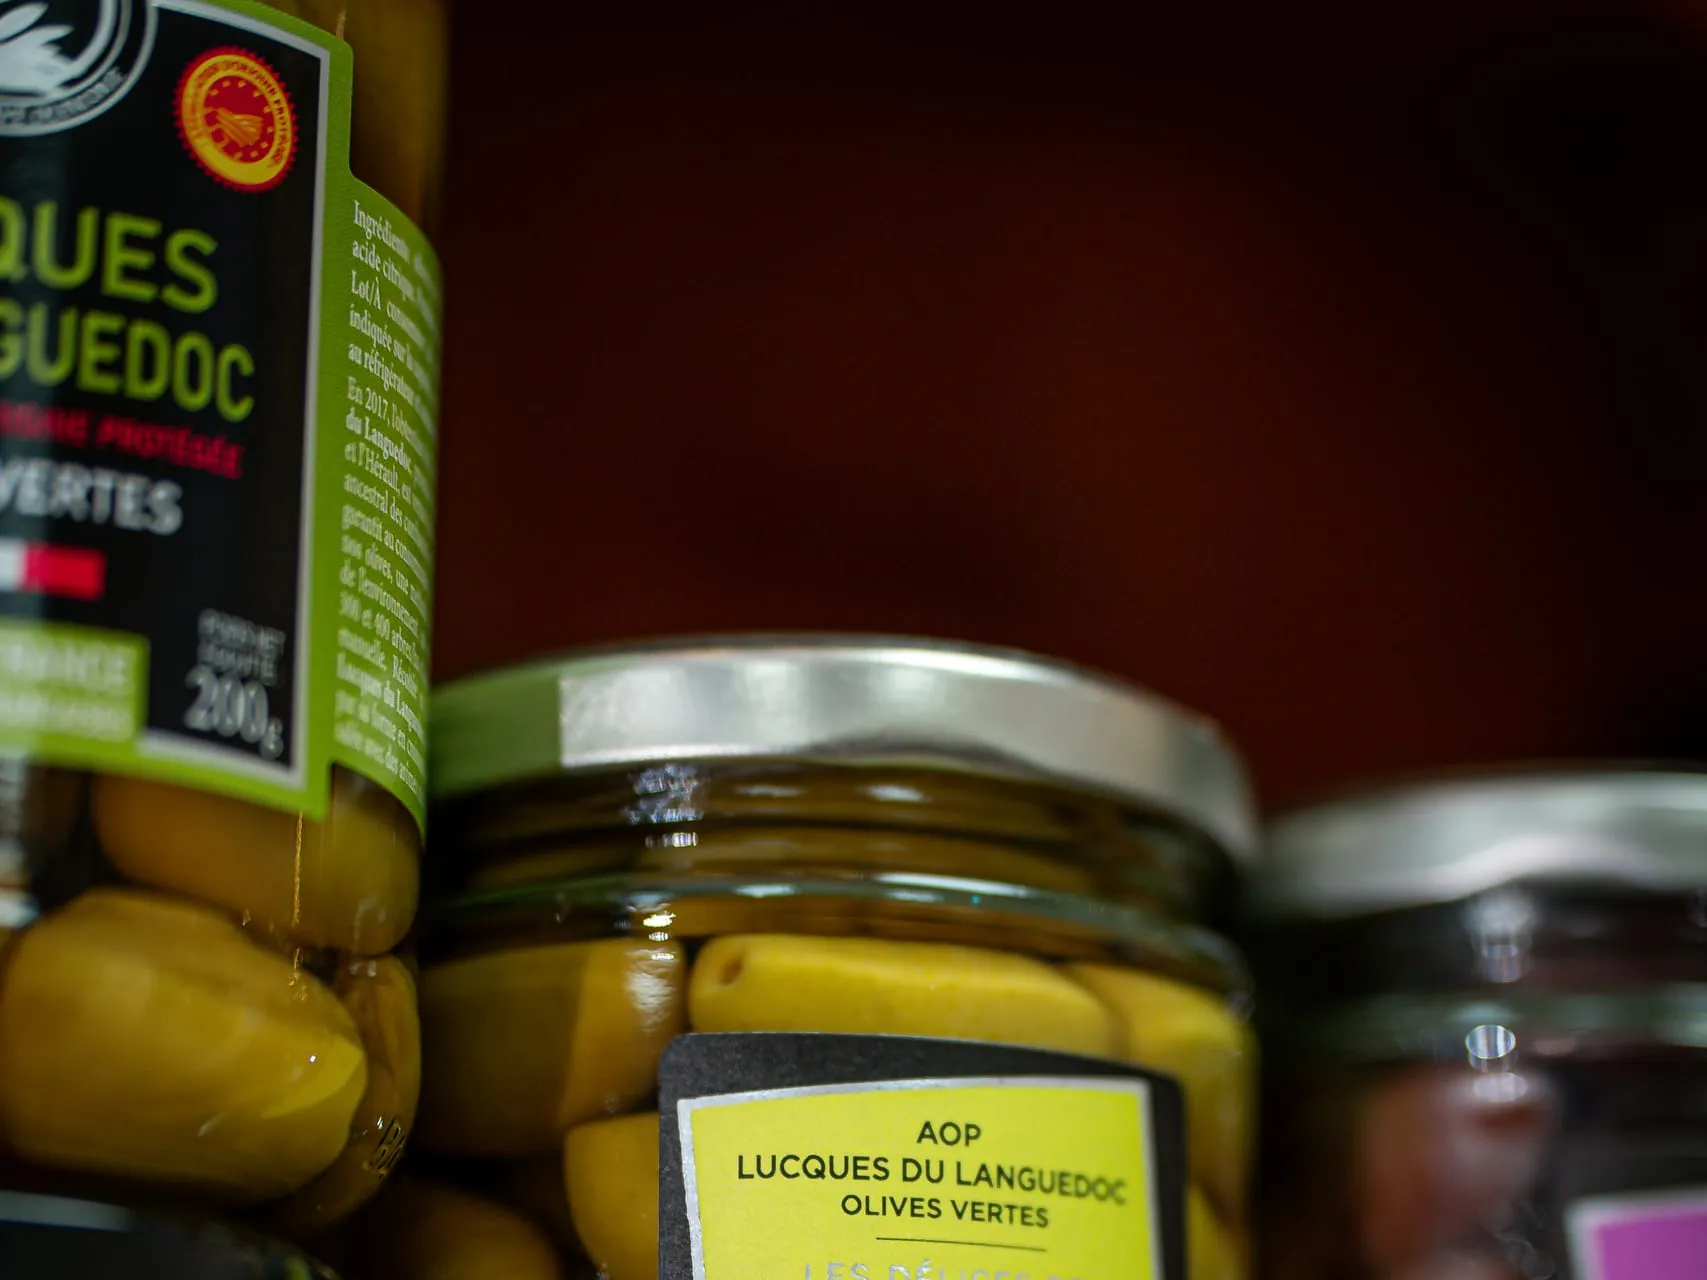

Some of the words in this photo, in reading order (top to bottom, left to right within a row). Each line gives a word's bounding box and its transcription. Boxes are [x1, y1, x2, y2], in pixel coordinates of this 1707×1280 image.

[353, 240, 381, 271] acide
[351, 269, 382, 310] Lot/À
[349, 303, 393, 352] indiquée
[347, 375, 363, 405] En
[916, 1120, 983, 1147] AOP
[737, 1153, 891, 1183] LUCQUES
[901, 1158, 945, 1185] DU
[956, 1162, 1129, 1206] LANGUEDOC
[841, 1193, 943, 1219] OLIVES
[951, 1198, 1050, 1228] VERTES
